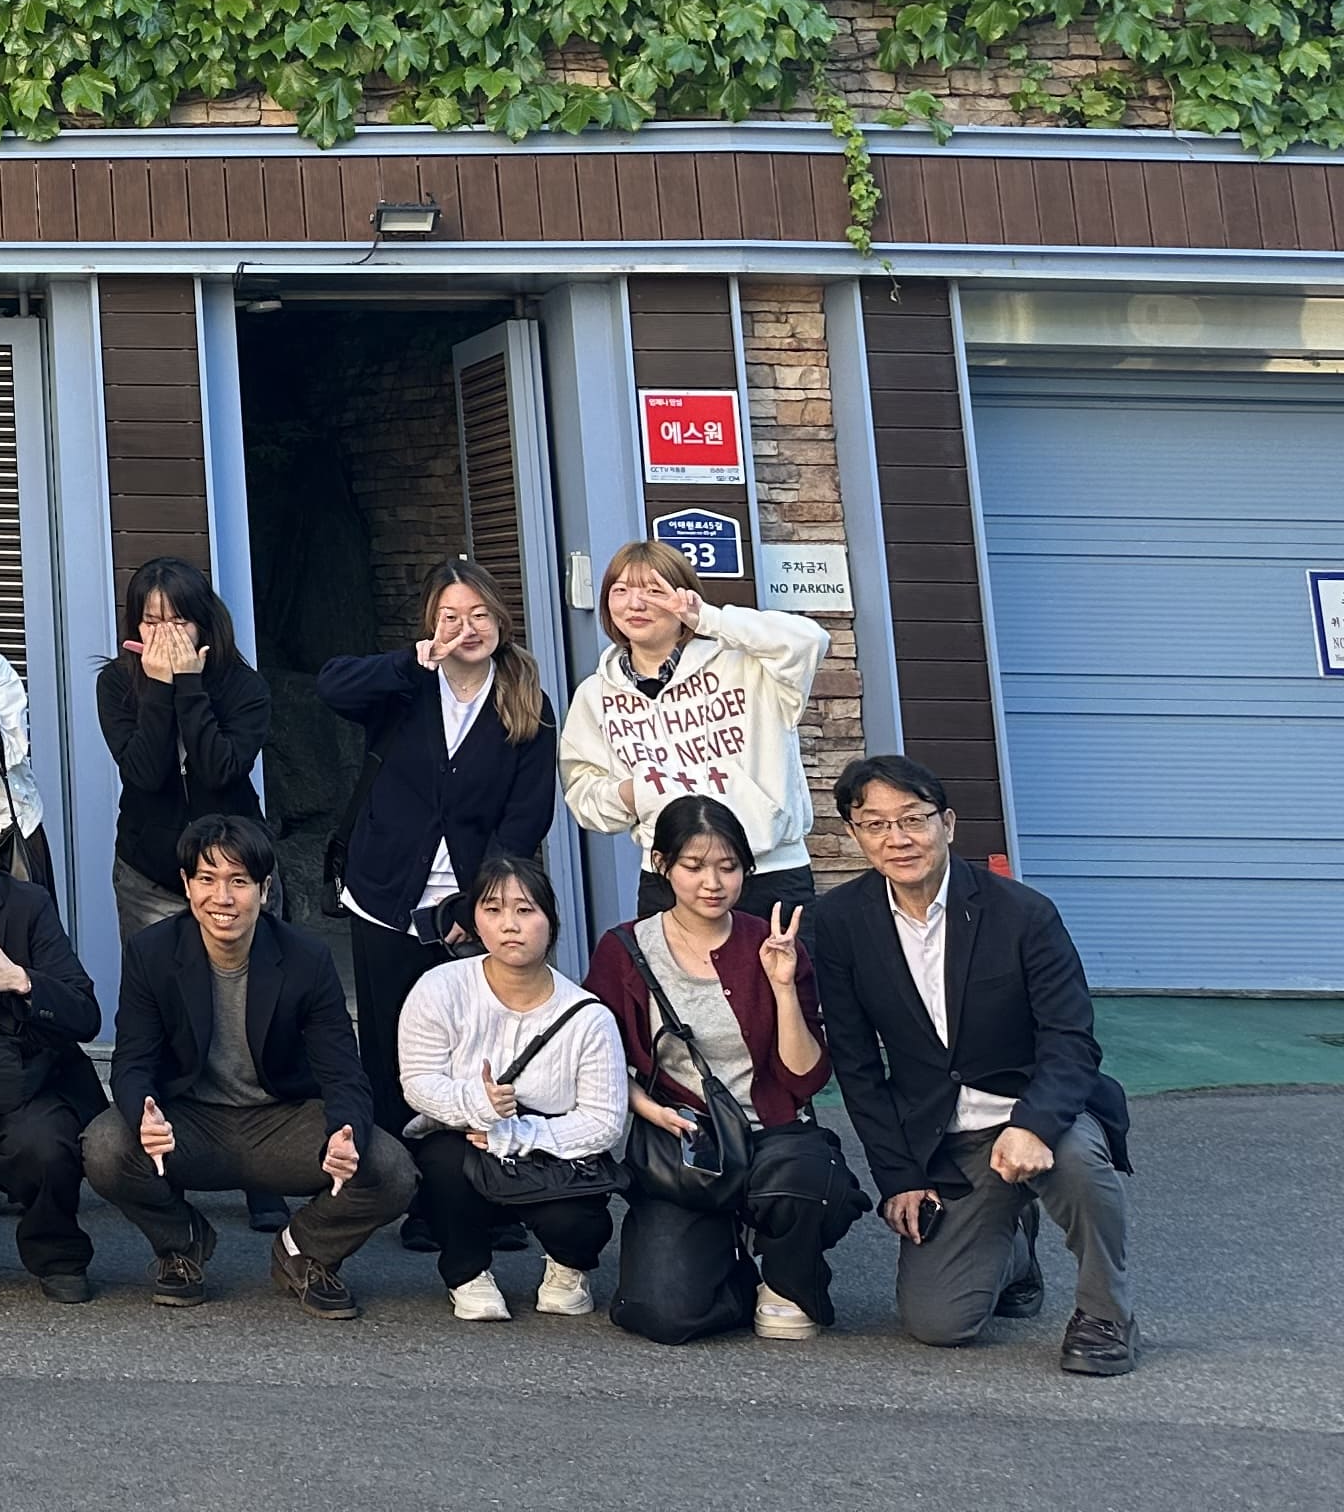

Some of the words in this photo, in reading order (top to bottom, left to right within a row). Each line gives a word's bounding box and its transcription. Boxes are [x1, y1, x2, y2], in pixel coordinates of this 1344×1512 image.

[659, 421, 724, 445] 에스원
[681, 542, 716, 567] 33
[781, 561, 827, 574] 주차금지
[770, 583, 789, 594] NO
[793, 583, 845, 594] PARKING
[602, 693, 650, 714] PRA
[599, 714, 658, 744] ARTY
[674, 726, 745, 768] NEVER
